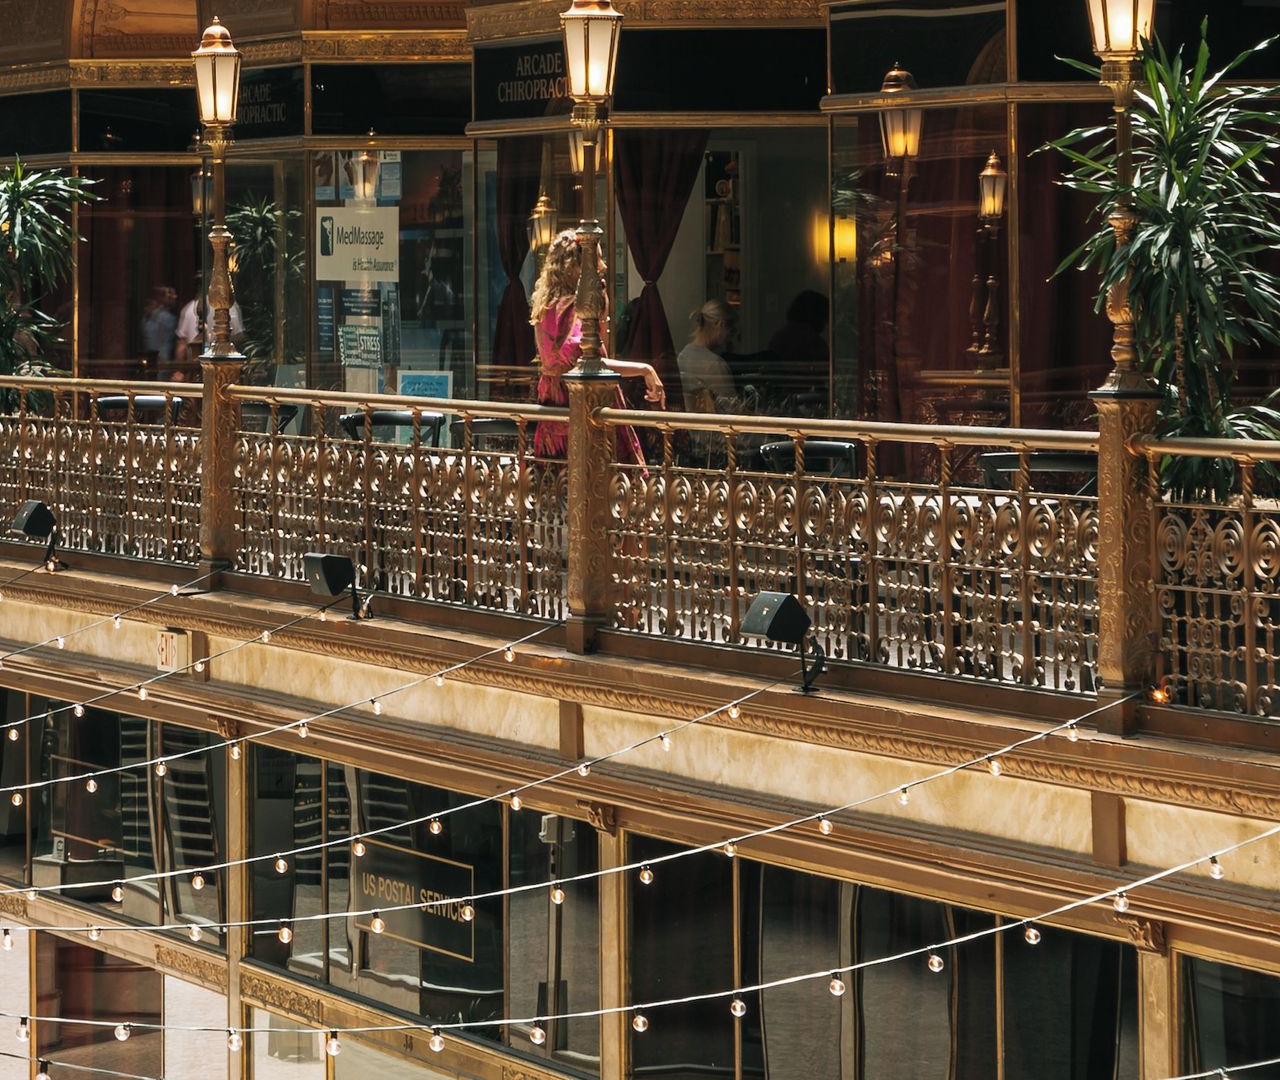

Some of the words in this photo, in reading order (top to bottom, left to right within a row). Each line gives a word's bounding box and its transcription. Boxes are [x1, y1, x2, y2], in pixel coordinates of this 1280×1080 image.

[516, 53, 563, 77] ARCADE
[239, 83, 272, 104] RCADE
[497, 76, 568, 103] CHIROPRACT
[336, 226, 384, 250] MedMassage
[359, 335, 381, 351] STRESS
[362, 871, 376, 897] US
[378, 876, 415, 906] POSTAL
